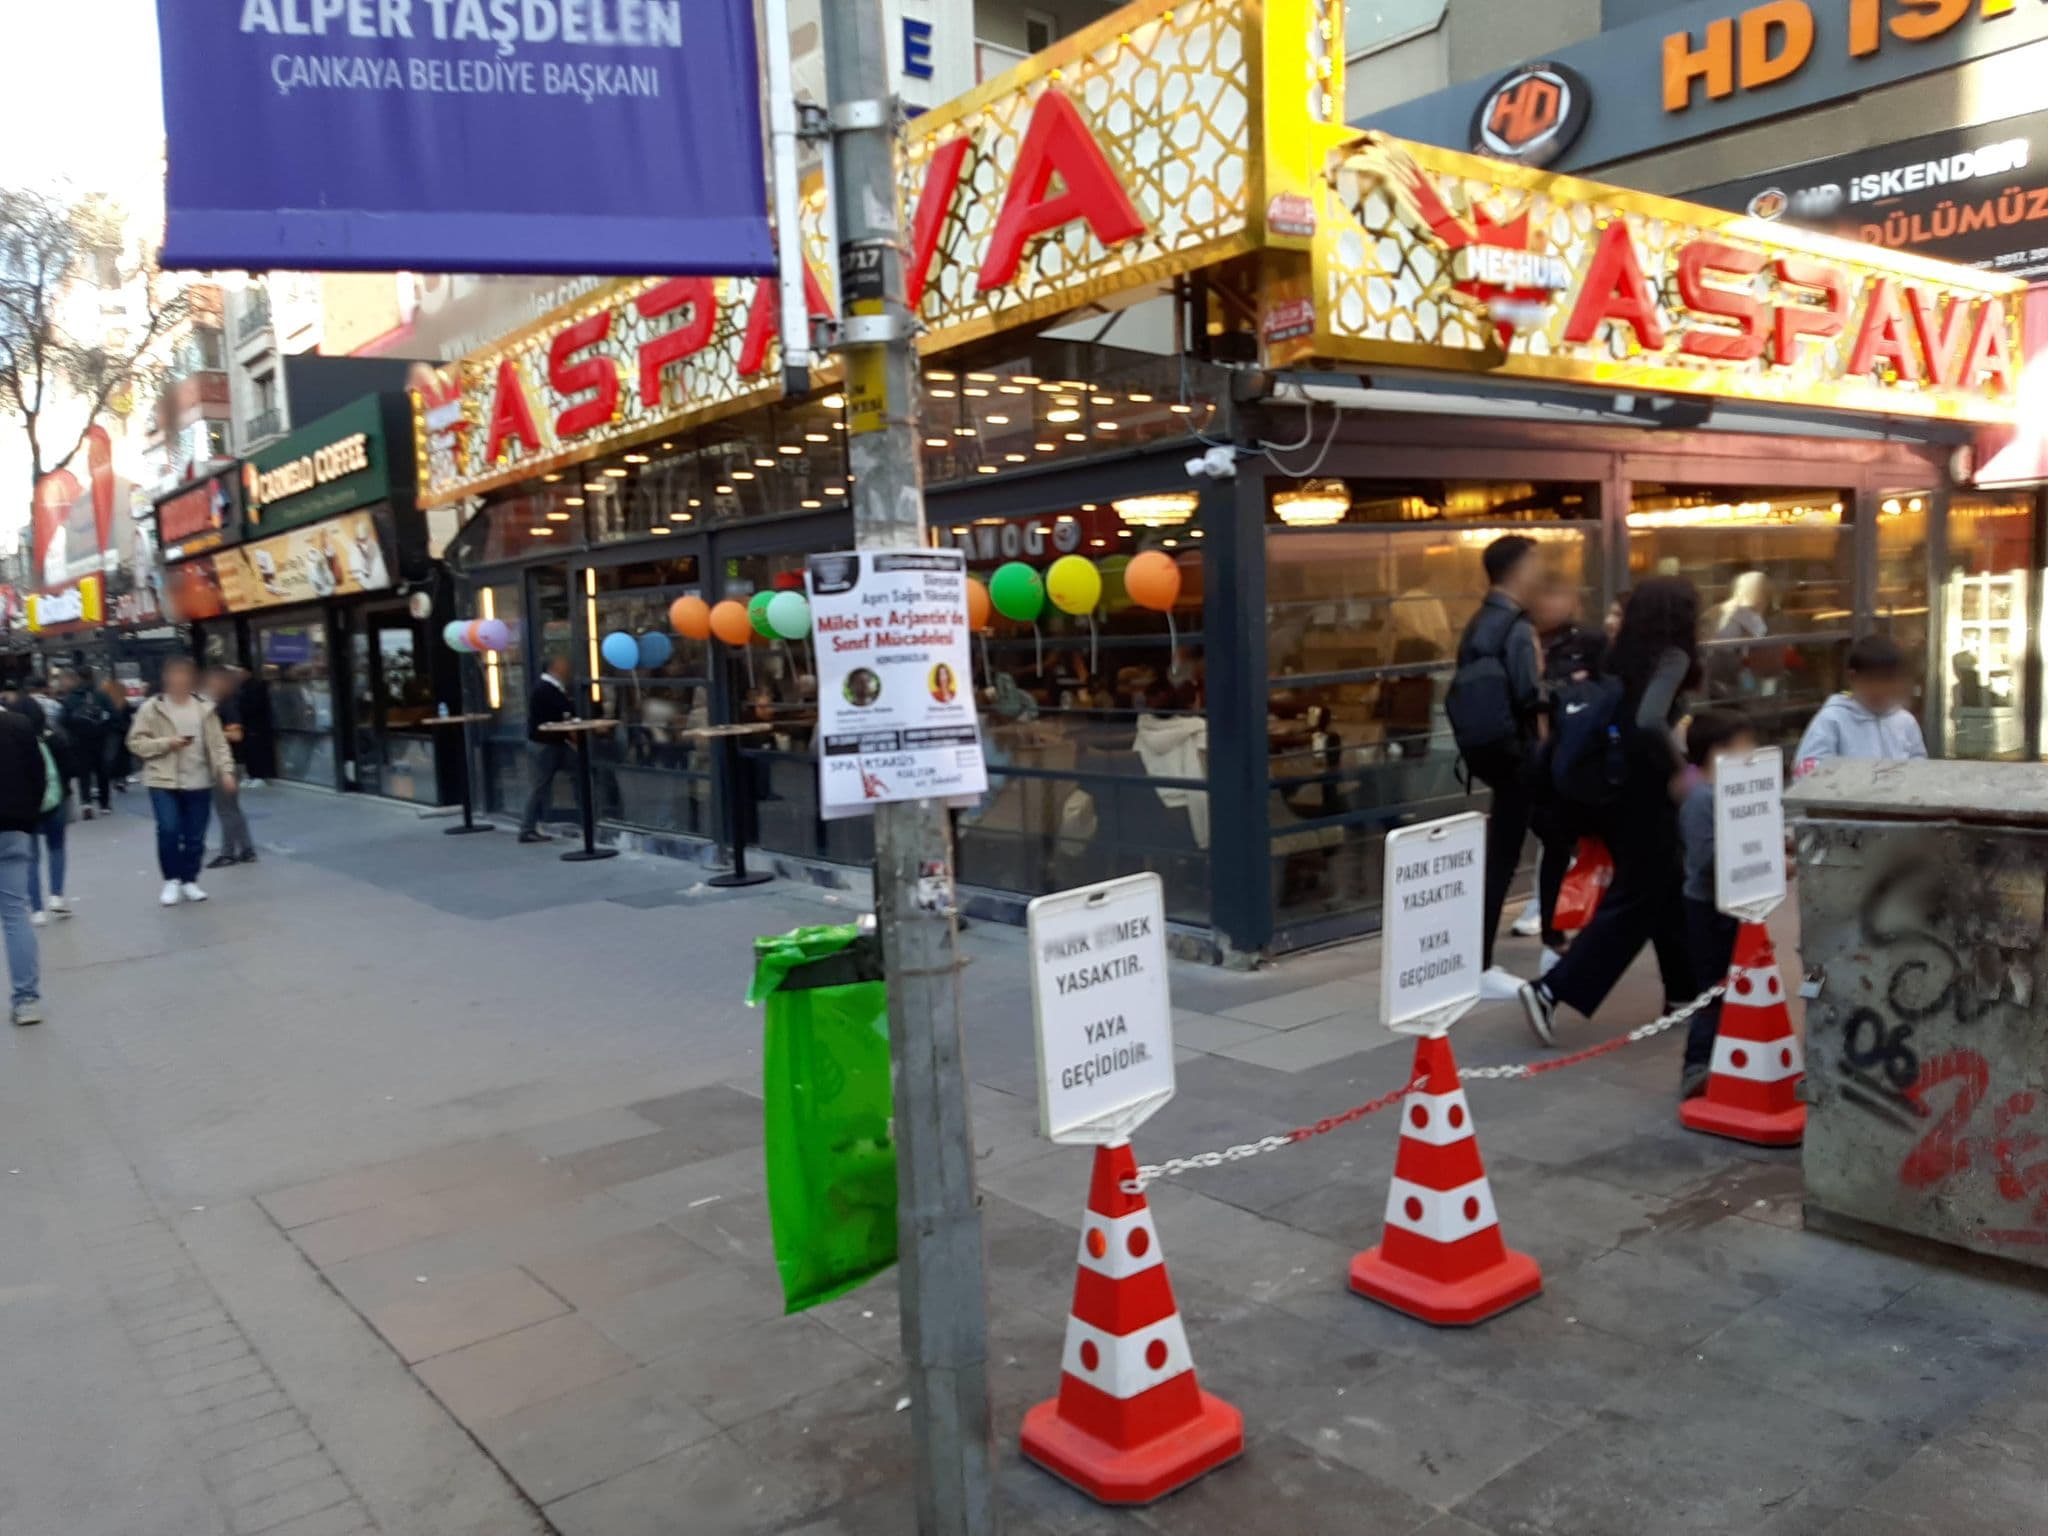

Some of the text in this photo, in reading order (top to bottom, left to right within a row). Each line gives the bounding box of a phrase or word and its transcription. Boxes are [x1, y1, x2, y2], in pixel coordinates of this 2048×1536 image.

[240, 0, 682, 56] ALPER TAŞDELEN
[271, 54, 659, 103] ÇANKAYA BELEDİYE BAŞKANI
[1661, 0, 1815, 112] HD
[1488, 78, 1561, 147] HD
[1563, 220, 2015, 392] ASPAVA
[314, 432, 369, 483] COFFEE
[1396, 848, 1474, 883] PARK ETMEK
[1418, 930, 1449, 952] YAYA
[1056, 954, 1144, 996] YASAKTIR.
[1084, 1013, 1128, 1045] YAYA
